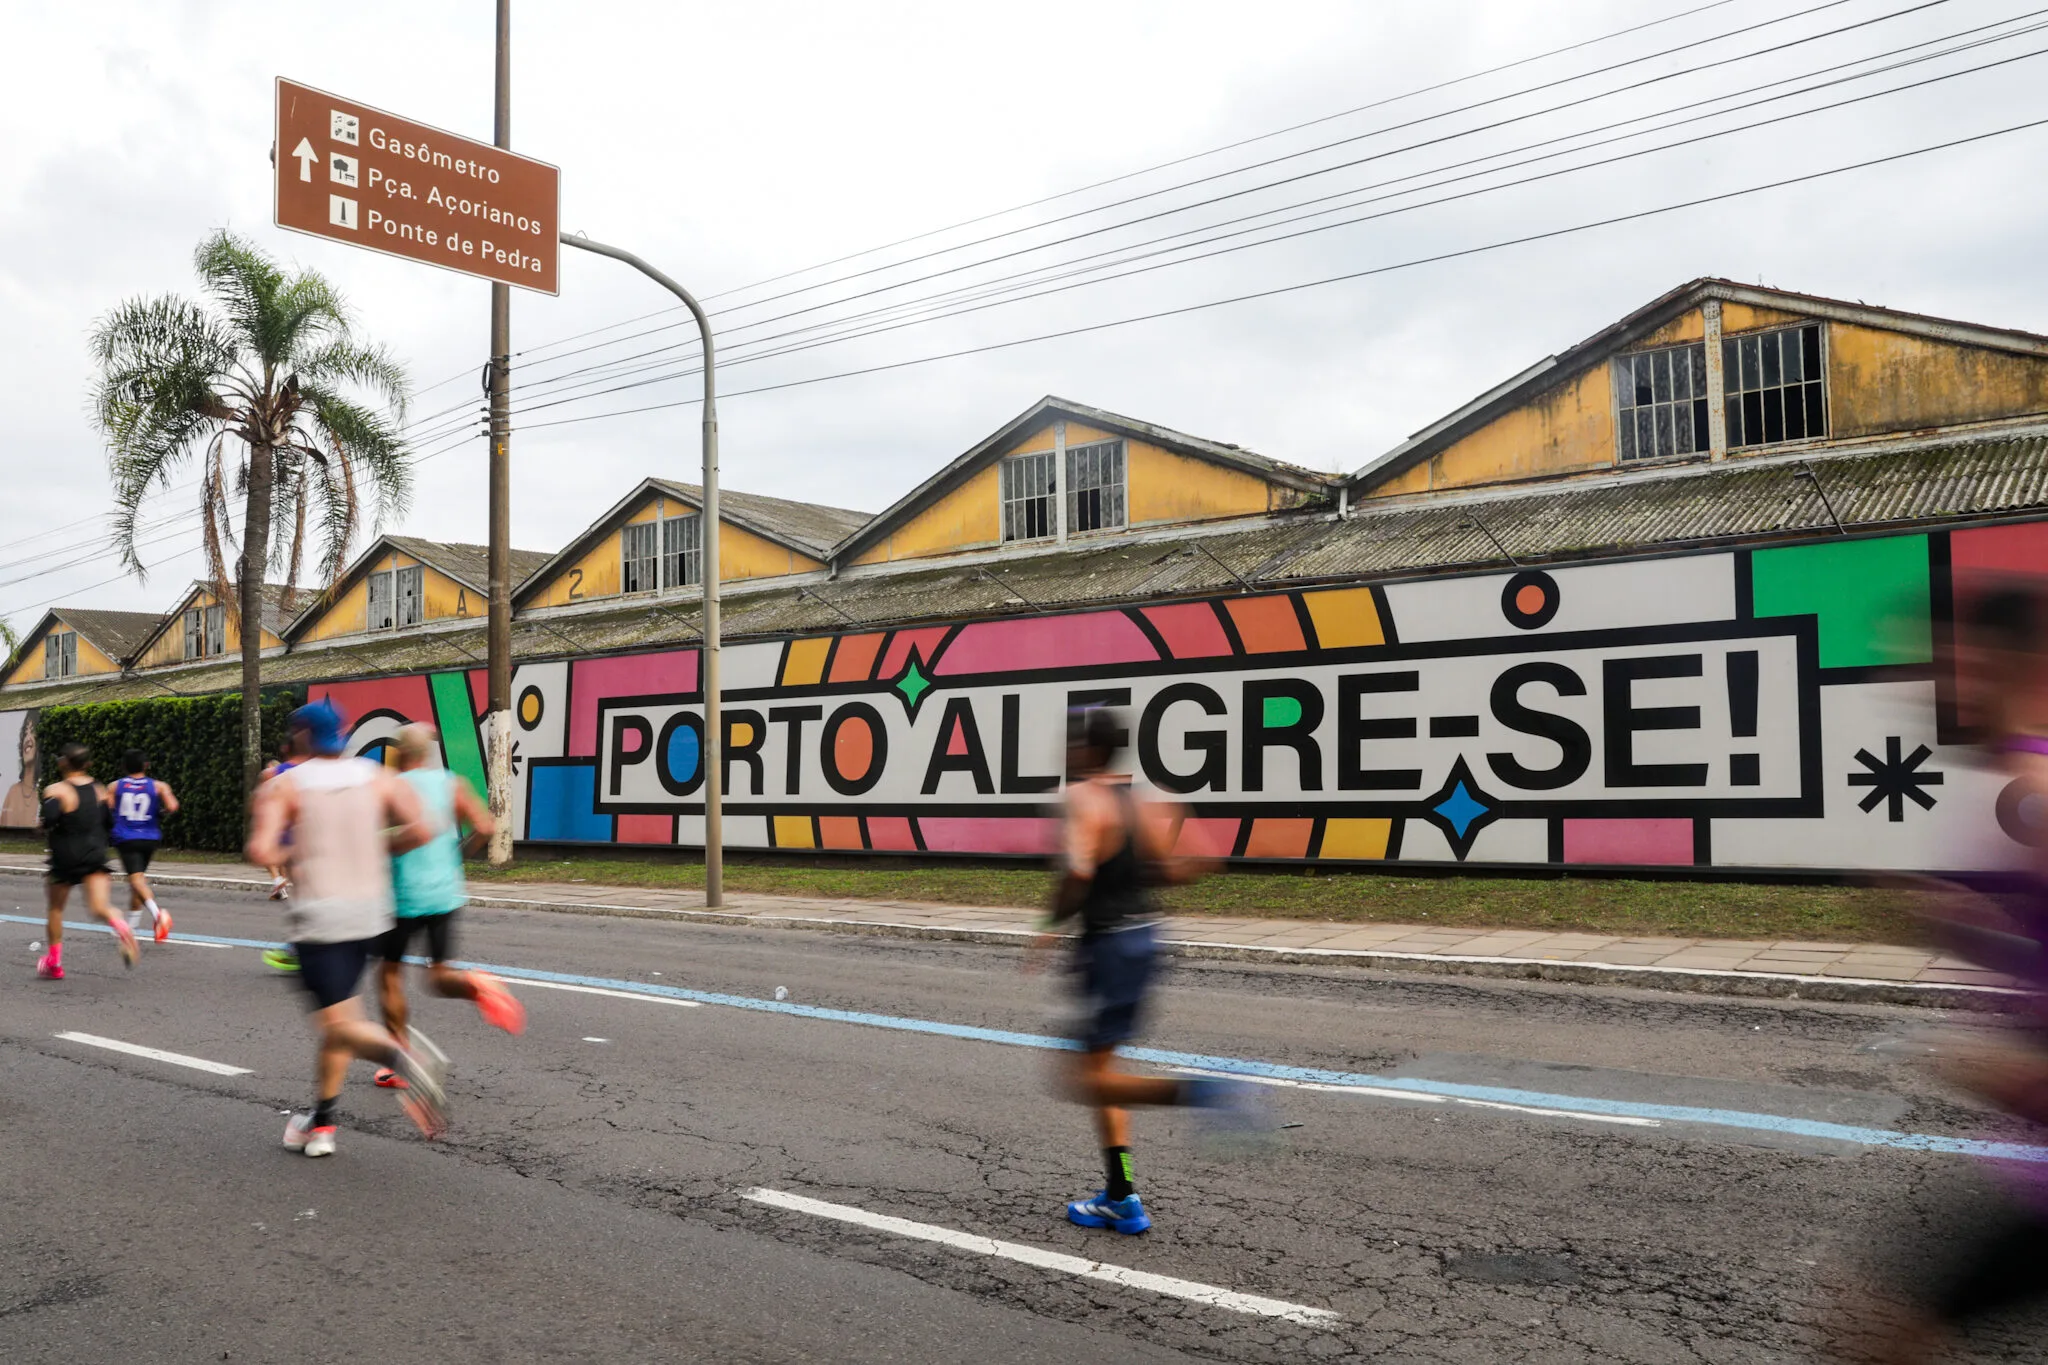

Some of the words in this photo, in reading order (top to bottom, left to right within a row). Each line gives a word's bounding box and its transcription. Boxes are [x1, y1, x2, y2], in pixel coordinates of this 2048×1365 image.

[369, 127, 500, 185] Gasômetro
[368, 167, 418, 200] Pça.
[427, 186, 541, 236] Açorianos
[368, 209, 438, 246] Ponte
[446, 233, 474, 256] de
[481, 240, 542, 273] Pedra
[569, 569, 583, 599] 2
[609, 701, 888, 796] PORTO
[119, 791, 152, 821] 42
